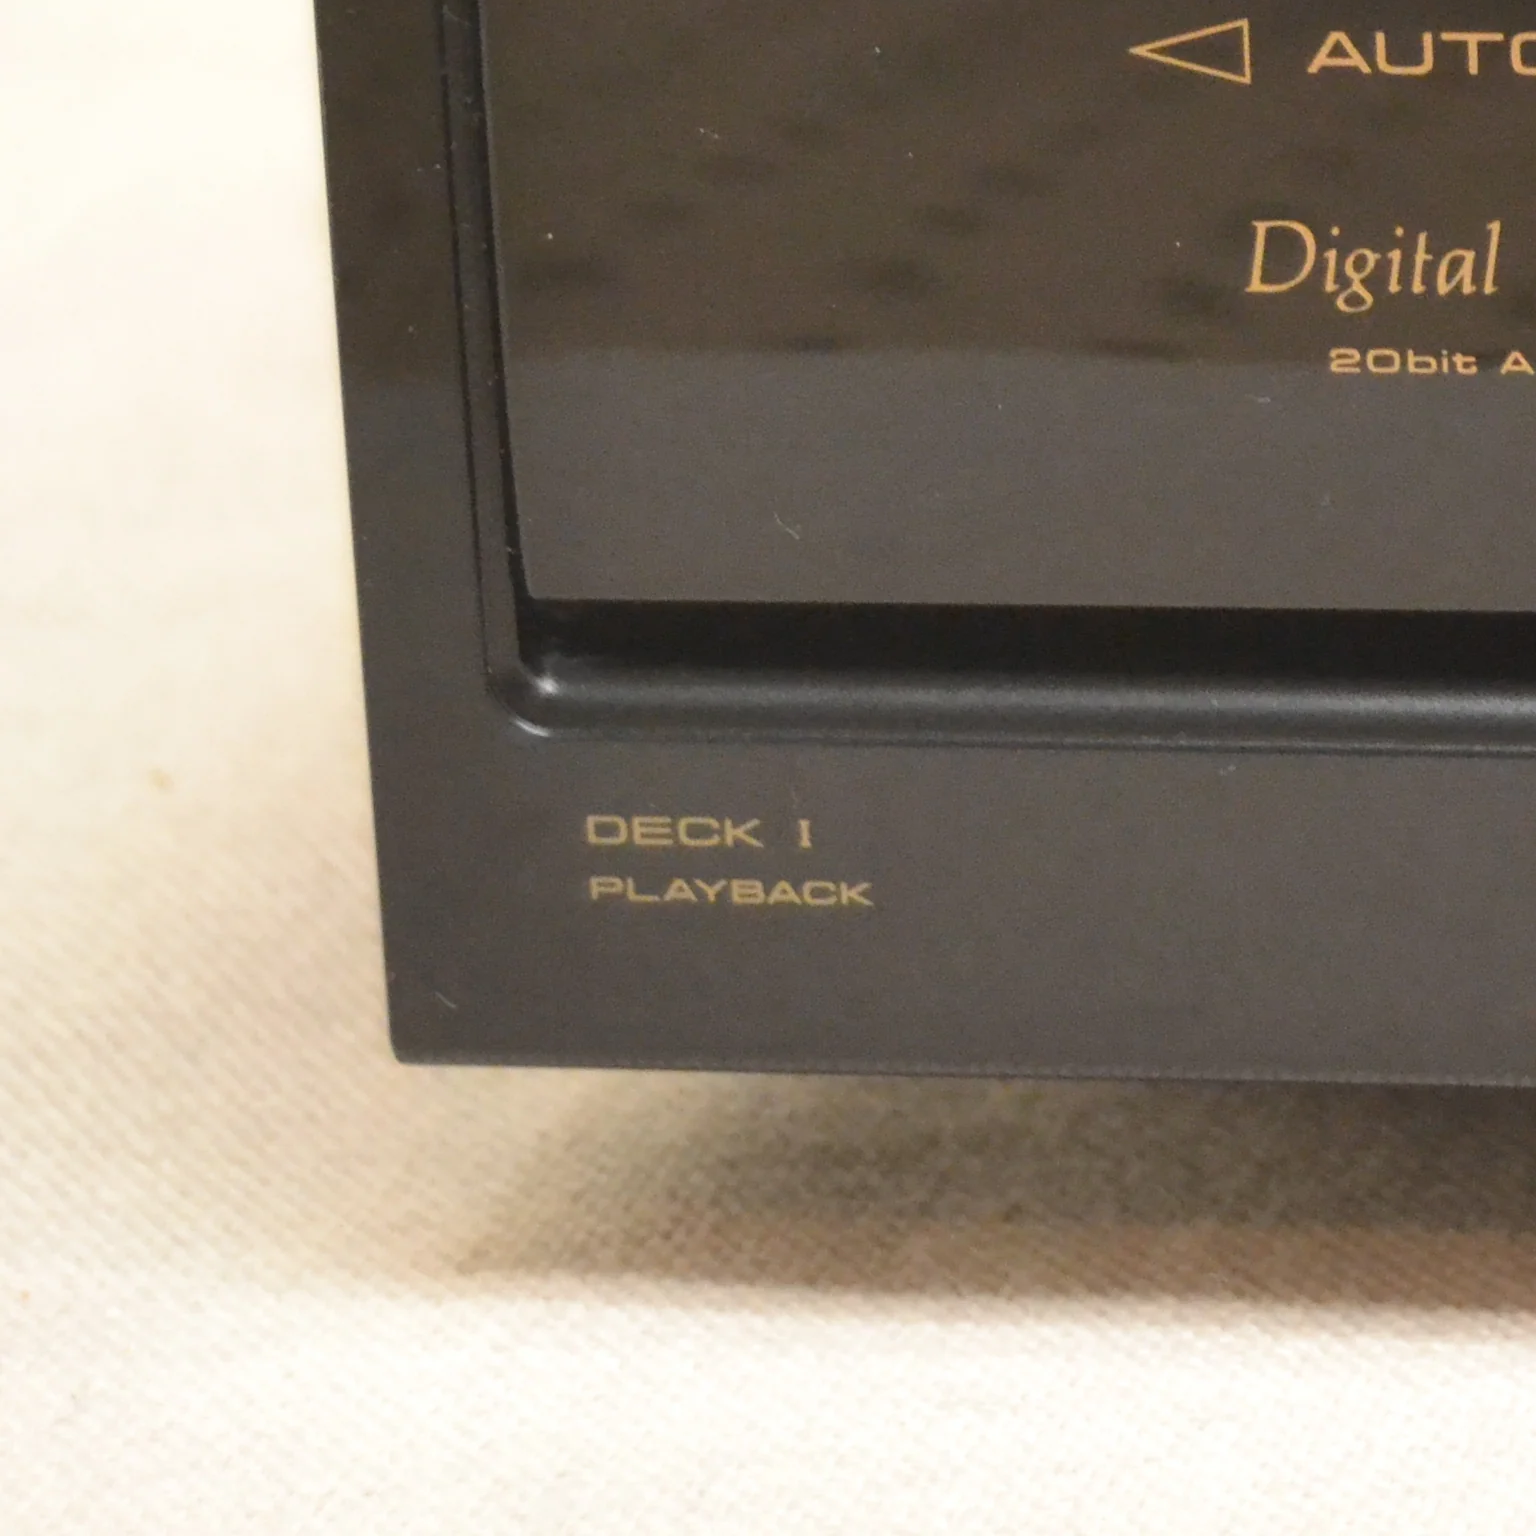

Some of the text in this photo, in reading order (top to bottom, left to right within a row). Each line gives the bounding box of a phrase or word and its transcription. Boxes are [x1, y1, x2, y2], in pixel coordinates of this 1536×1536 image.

[1245, 220, 1501, 313] Digital
[1329, 347, 1478, 376] 20bit
[585, 815, 763, 848] DECK
[589, 876, 872, 906] PLAYBACK
